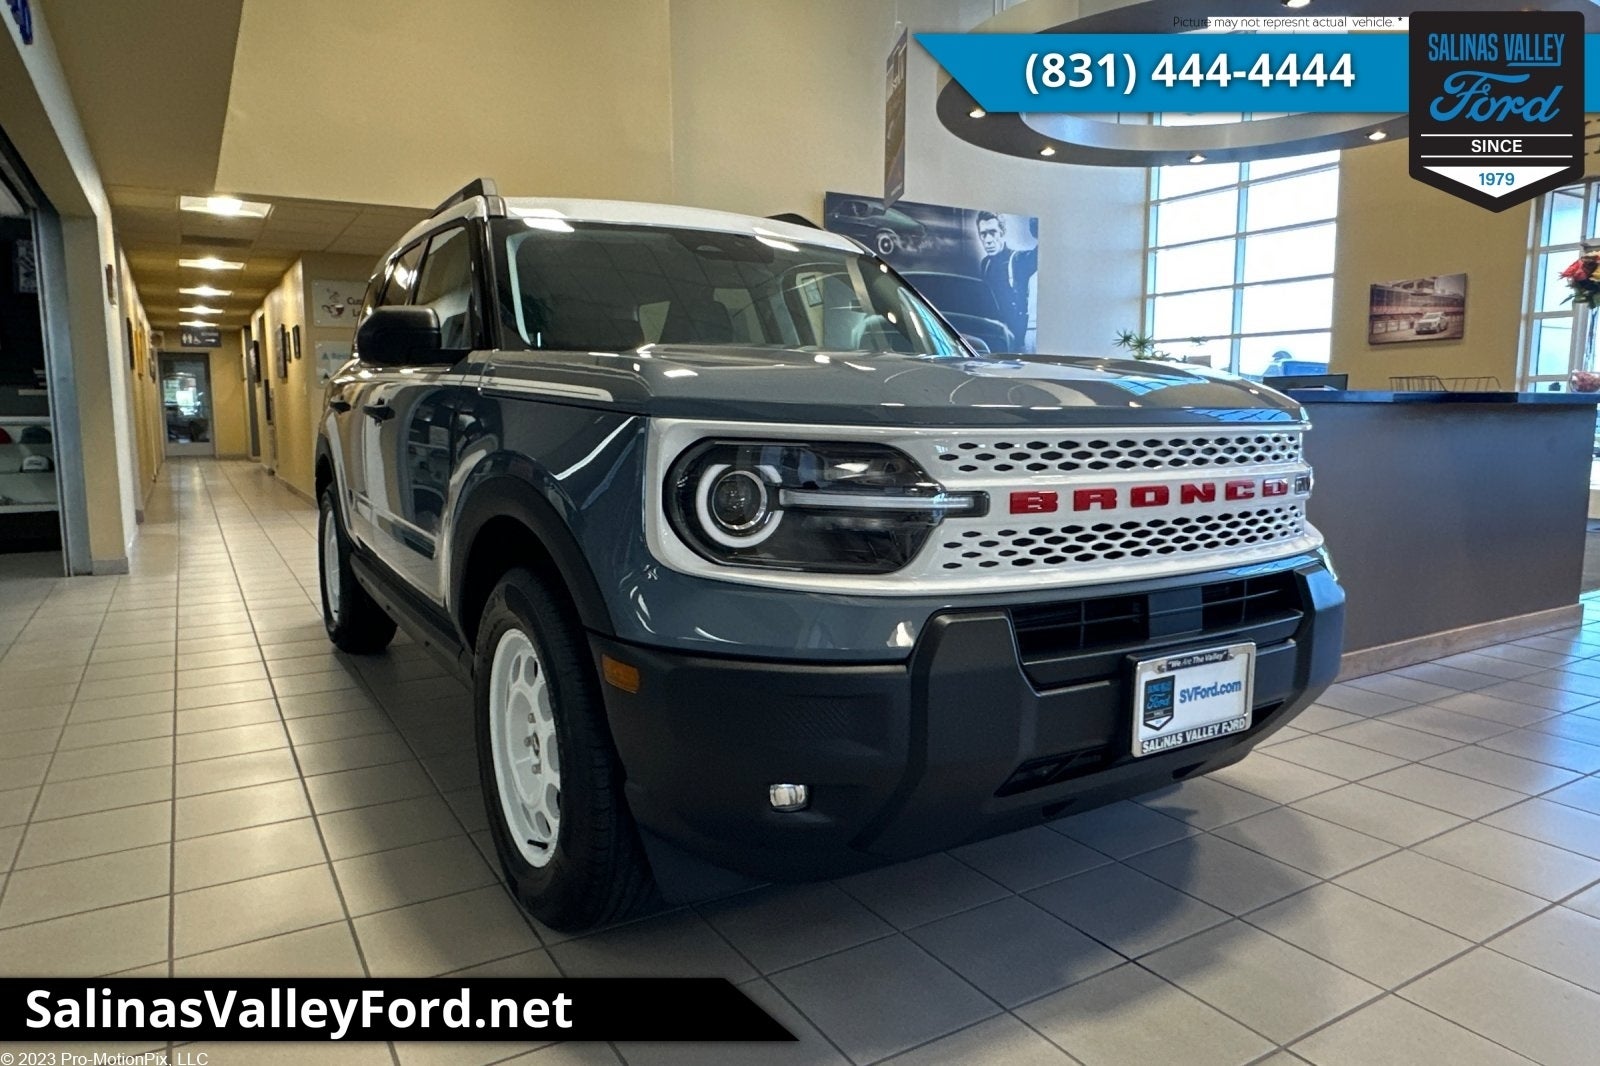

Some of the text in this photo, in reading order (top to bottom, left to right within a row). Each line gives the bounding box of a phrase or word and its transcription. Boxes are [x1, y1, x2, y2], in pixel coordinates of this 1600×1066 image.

[1009, 478, 1288, 515] BRONCO
[1179, 681, 1242, 704] SVFord.com
[1142, 717, 1246, 753] SALINAS VALLEY FORD
